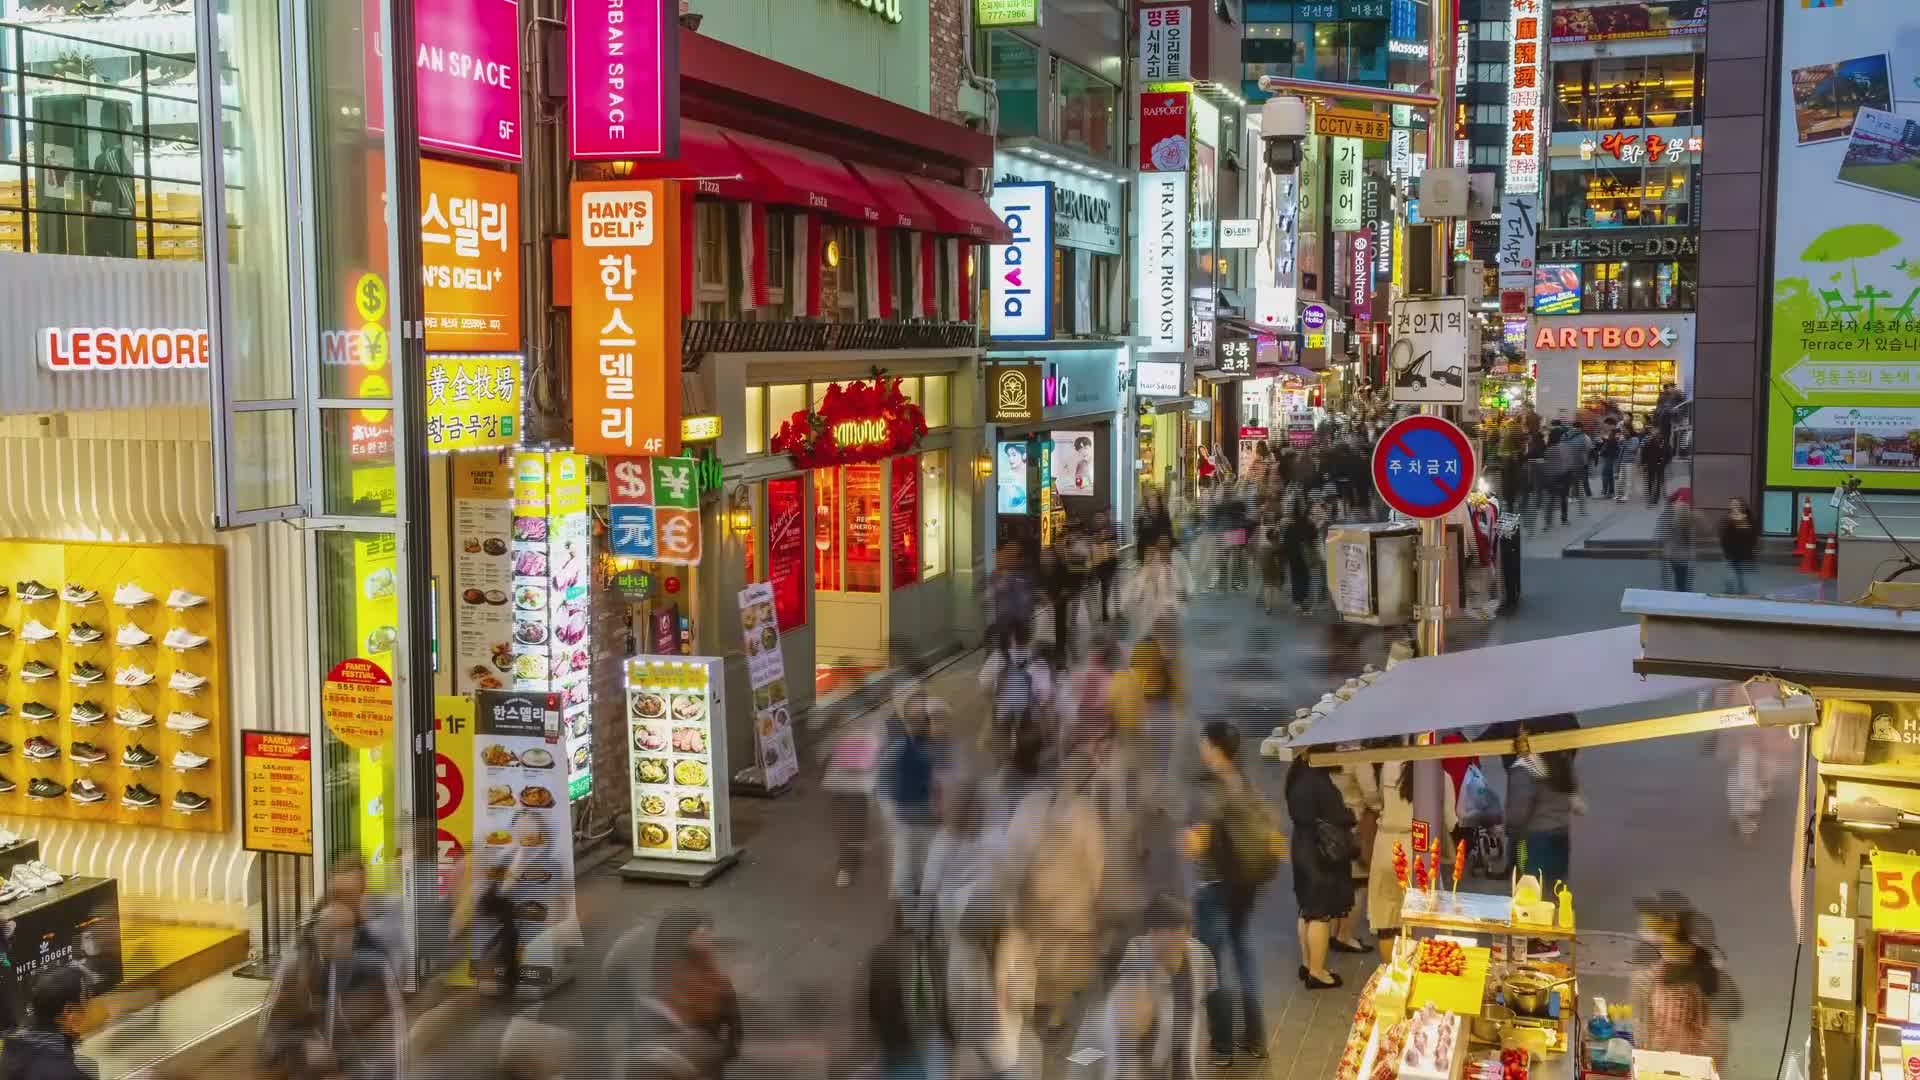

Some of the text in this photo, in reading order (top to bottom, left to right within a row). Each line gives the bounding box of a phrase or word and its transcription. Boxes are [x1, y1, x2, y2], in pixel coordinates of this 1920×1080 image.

[1301, 5, 1384, 17] 김선영 미용실
[1147, 29, 1161, 78] 시계수리
[1167, 28, 1181, 77] 오리엔트
[1389, 40, 1429, 58] Massage
[449, 51, 512, 90] SPACE
[608, 63, 625, 140] SPACE
[1143, 106, 1184, 116] RAPPORT
[499, 120, 514, 140] 5F
[1320, 118, 1385, 137] CCTV 녹화중
[699, 179, 720, 193] Pizza
[1339, 146, 1356, 211] 가헤어
[588, 201, 647, 218] HAN'S
[809, 192, 828, 209] Pasta
[864, 207, 879, 220] Wine
[421, 193, 507, 257] 스델리
[1378, 220, 1389, 272] ARITAUM
[1551, 239, 1590, 258] THE
[1005, 206, 1031, 316] lalavla
[1161, 182, 1175, 342] FRANCK PROVOST
[1398, 312, 1461, 334] 견인지역
[1801, 320, 1858, 334] 엠프라자
[1863, 319, 1900, 334] 4층과
[1536, 326, 1672, 349] ARTBOX
[1800, 337, 1920, 351] Terrace 가 있습니
[599, 254, 638, 448] 한스델리
[1222, 342, 1250, 356] 명동
[1221, 357, 1250, 370] 교자
[996, 410, 1031, 419] Mamonde
[427, 414, 498, 443] 황금목장
[644, 438, 664, 452] 4F
[615, 461, 646, 498] $
[658, 465, 690, 498] ¥
[615, 516, 651, 546] 元
[662, 516, 694, 552] €
[341, 670, 377, 680] FESTIVAL
[345, 663, 371, 671] FAMILY
[493, 705, 544, 723] 한스델리
[446, 715, 465, 734] 1F
[258, 744, 299, 755] FESTIVAL
[263, 736, 292, 745] FAMILY
[1876, 871, 1920, 911] 5
[16, 945, 73, 975] NITE JOGGER
